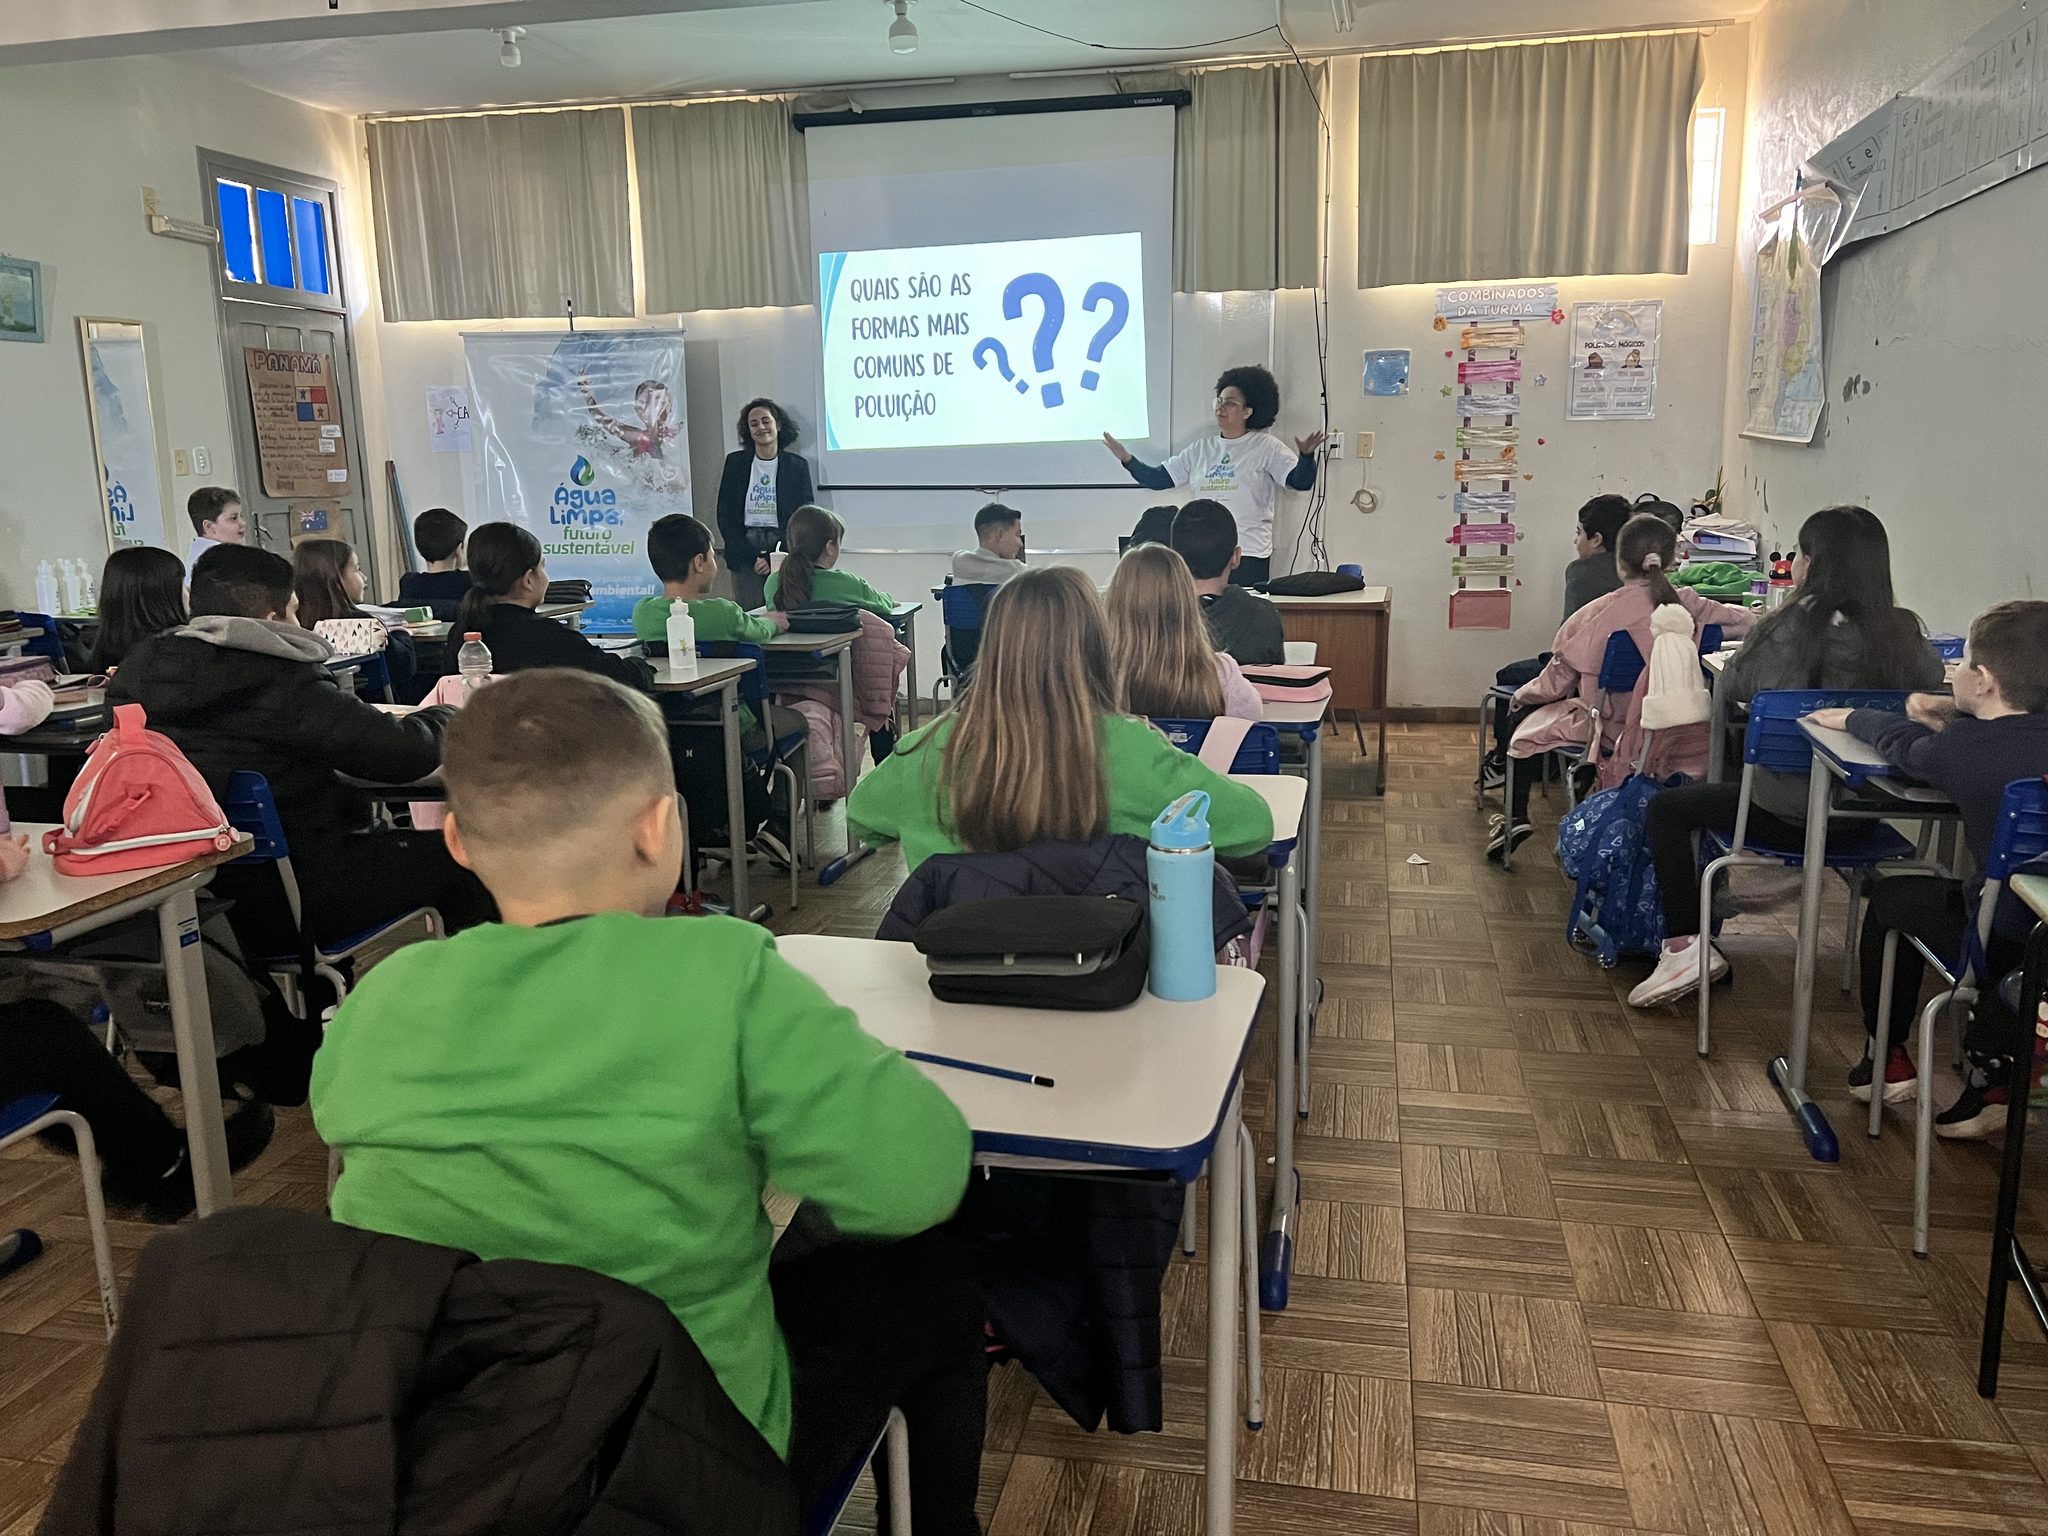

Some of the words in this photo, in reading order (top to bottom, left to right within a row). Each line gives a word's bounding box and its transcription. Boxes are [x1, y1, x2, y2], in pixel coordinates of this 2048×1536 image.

[1846, 156, 1856, 170] E
[1864, 148, 1873, 158] e
[850, 277, 899, 303] QUAIS
[908, 272, 941, 298] SÃO
[950, 272, 972, 297] AS
[1447, 287, 1545, 303] COMBINADOS
[1457, 305, 1477, 317] DA
[1482, 303, 1533, 316] TURMA
[852, 315, 920, 340] FORMAS
[927, 312, 970, 337] MAIS
[853, 353, 925, 379] COMUNS
[933, 352, 954, 376] DE
[855, 389, 936, 422] POLUIÇÃO
[554, 482, 616, 509] Água
[543, 540, 635, 555] sustentável
